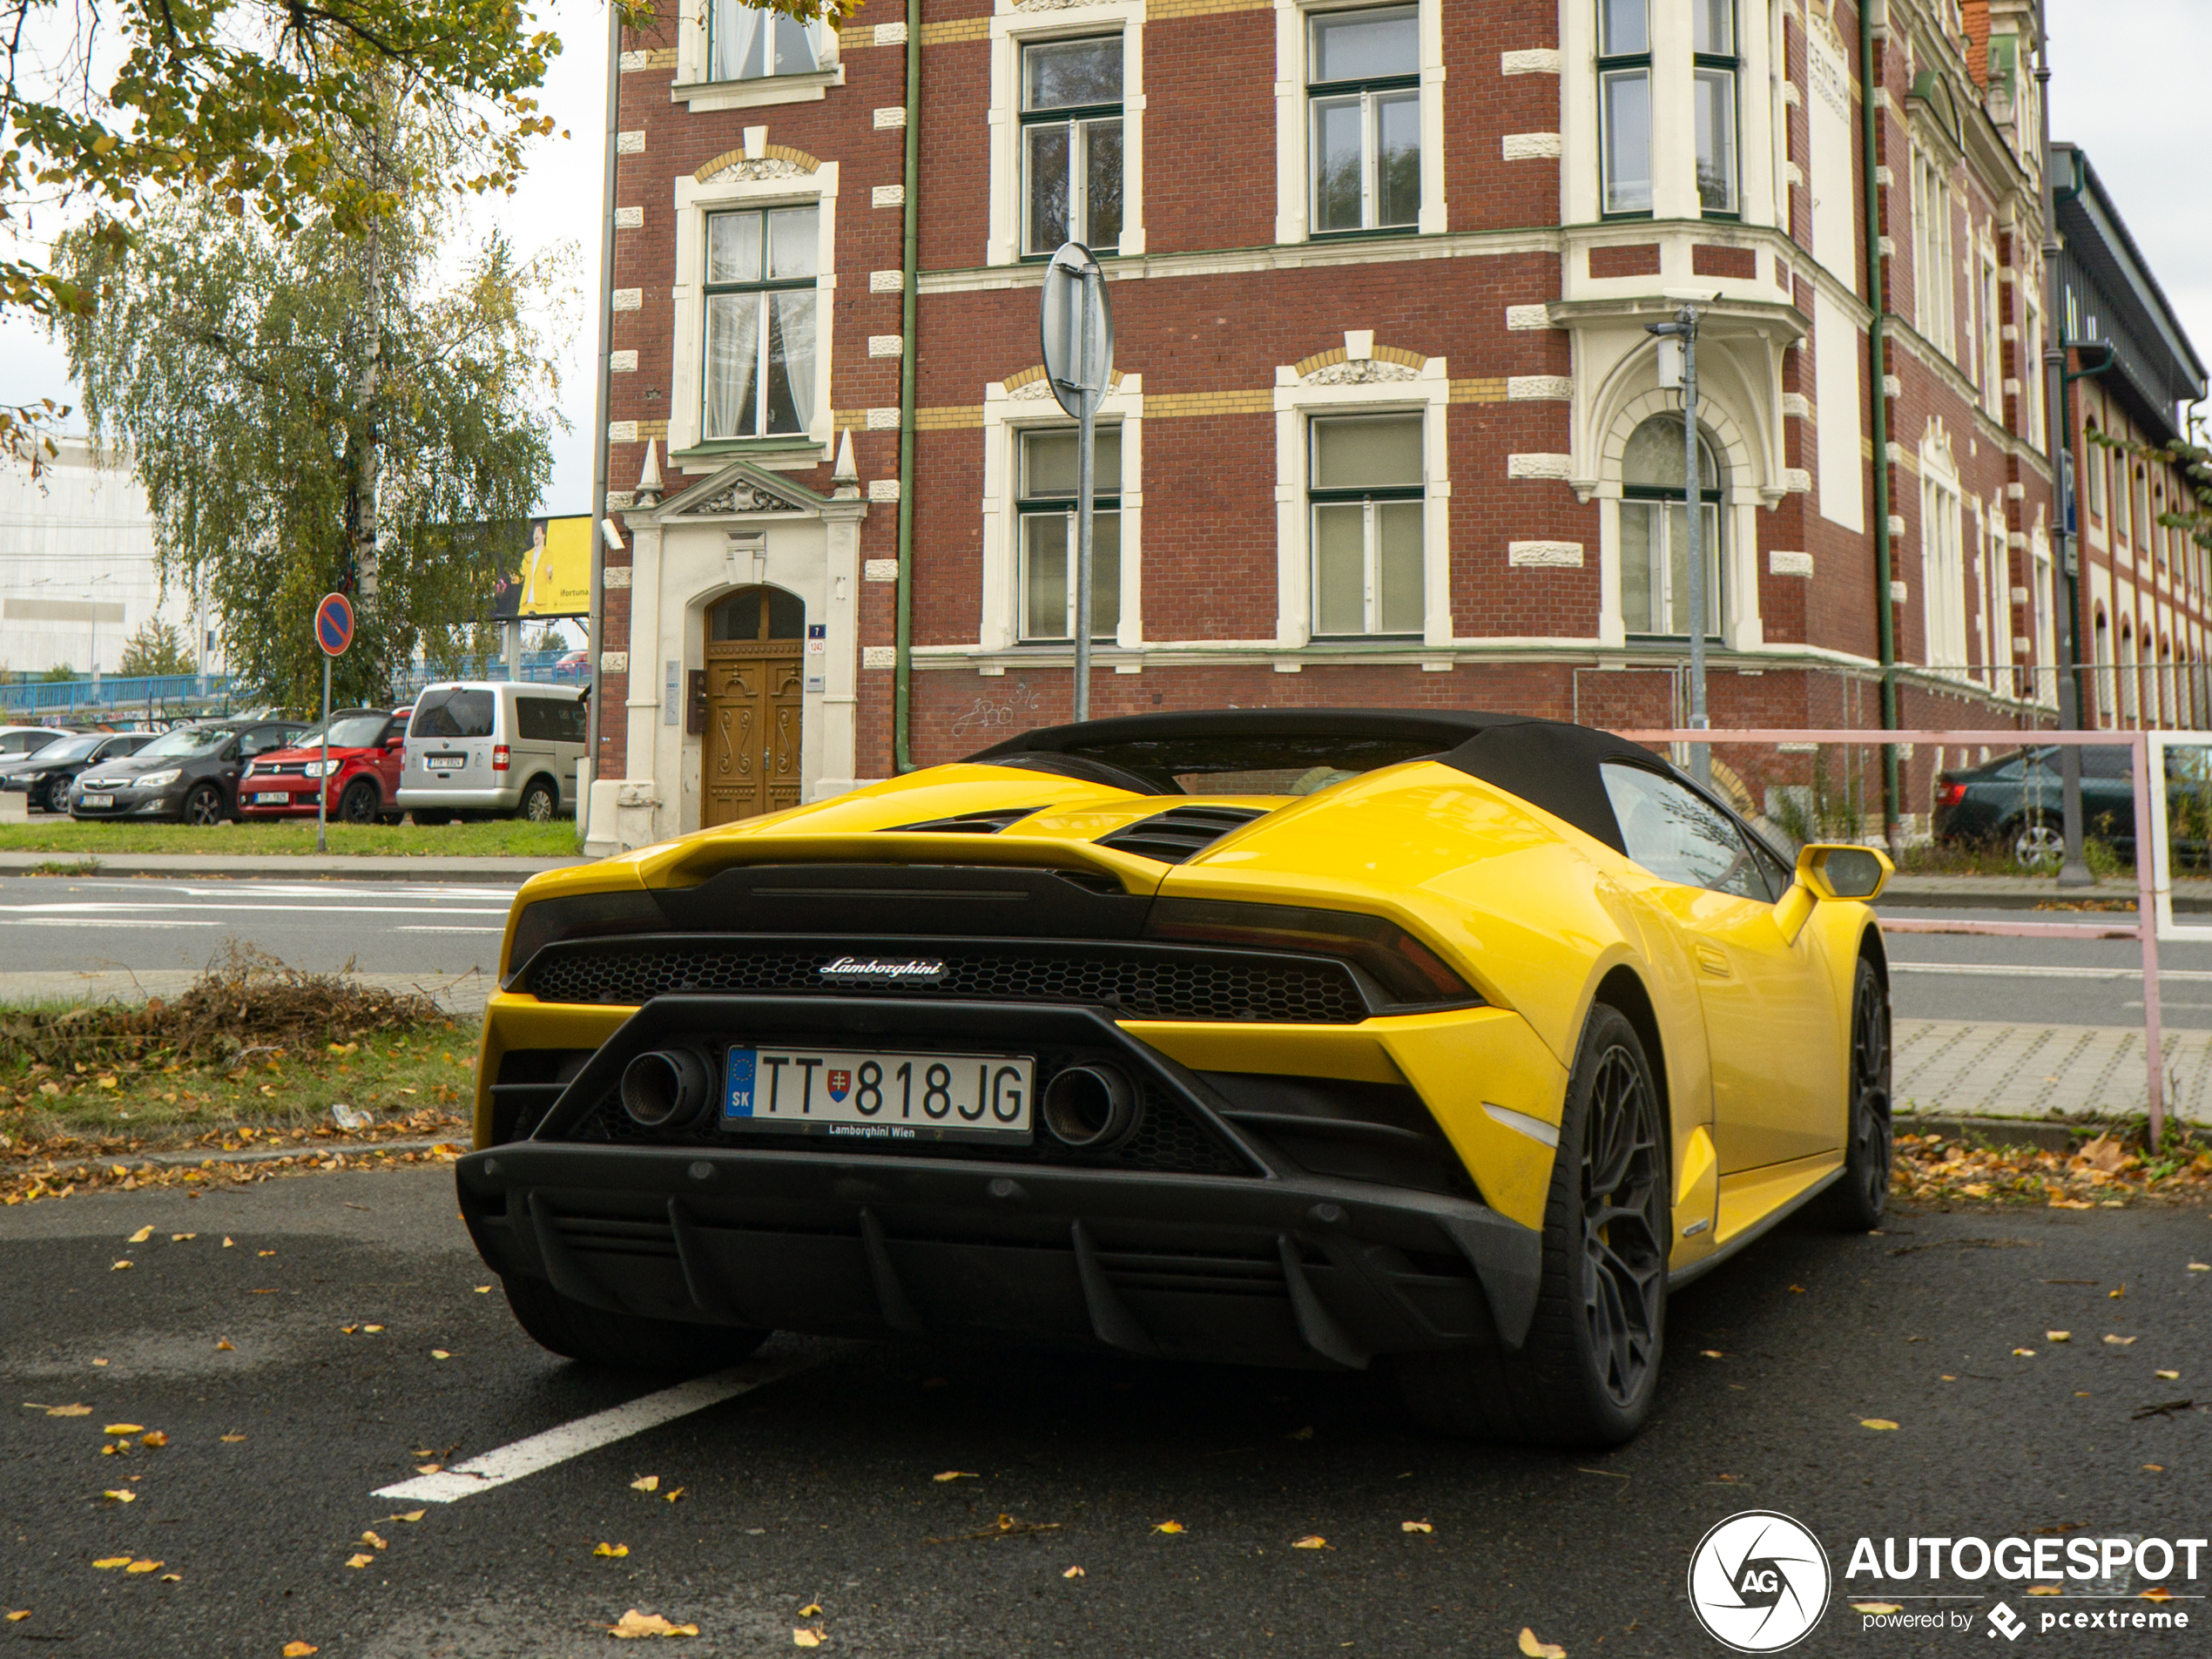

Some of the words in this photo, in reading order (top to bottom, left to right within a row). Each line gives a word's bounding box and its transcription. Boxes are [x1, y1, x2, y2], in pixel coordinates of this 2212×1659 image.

[1810, 41, 1850, 102] CENTRUM
[819, 956, 943, 978] Lamborghini
[763, 1055, 823, 1114] TT
[732, 1091, 749, 1108] SK
[829, 1123, 889, 1138] Lamborghini
[892, 1127, 915, 1138] Wien
